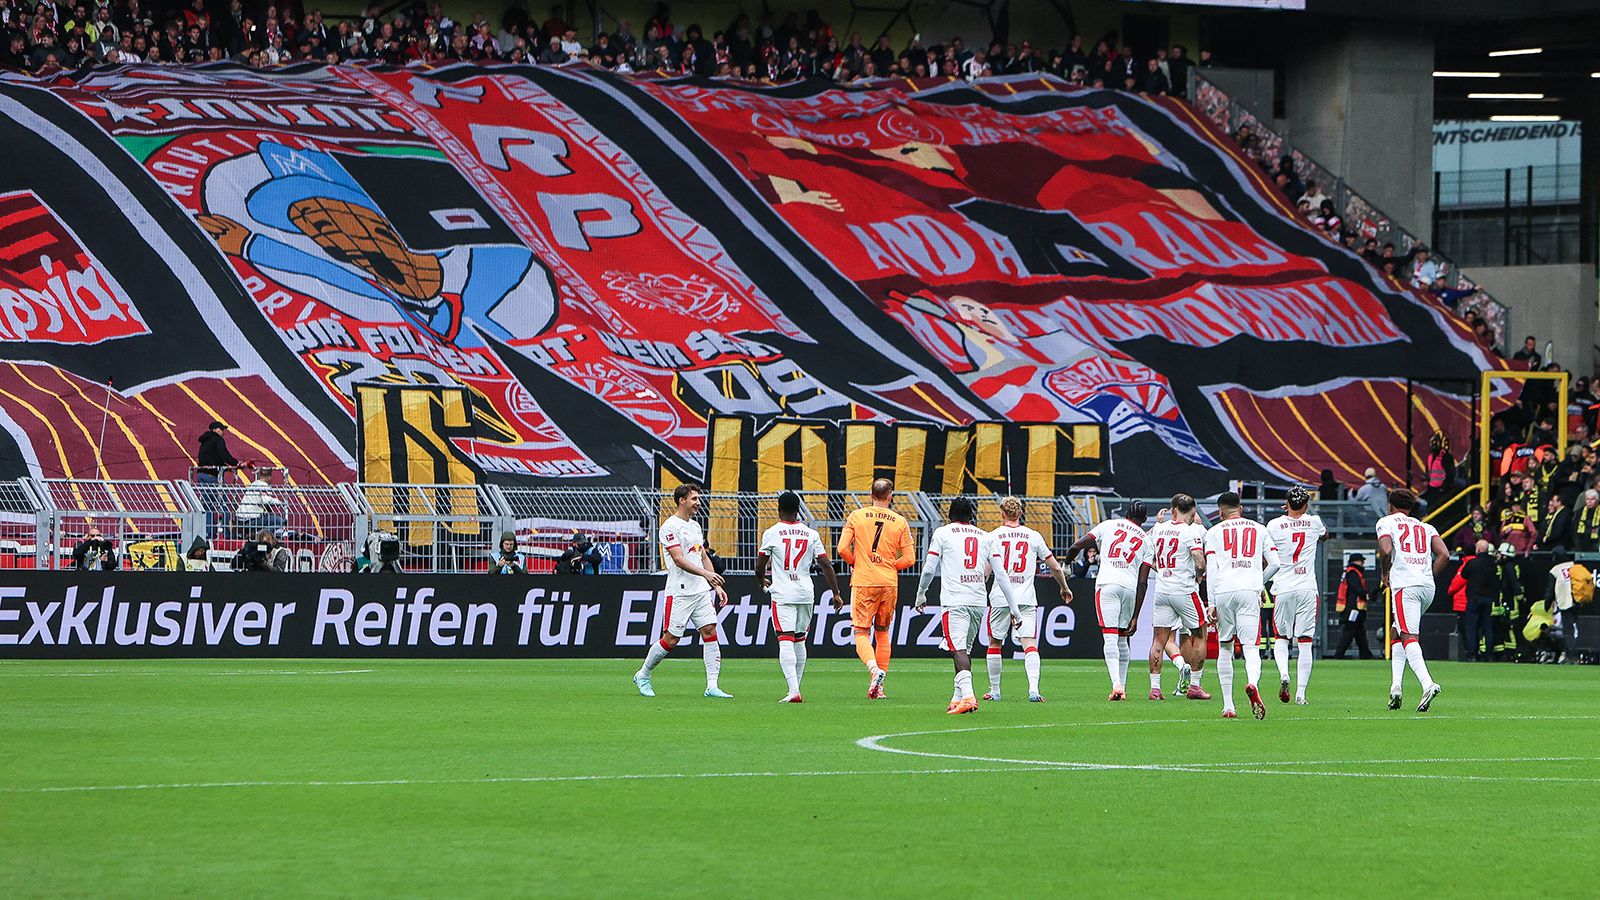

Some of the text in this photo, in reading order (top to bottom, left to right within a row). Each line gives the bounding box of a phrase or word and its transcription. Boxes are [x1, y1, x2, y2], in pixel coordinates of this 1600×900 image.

[1433, 124, 1568, 146] NTSCHEIDEND
[788, 528, 810, 537] LEIPZIG
[871, 521, 884, 553] 1
[1007, 532, 1030, 540] LEIPZIG
[1289, 520, 1311, 528] LEIPZIG
[1397, 523, 1427, 554] 20
[782, 538, 809, 571] 17
[963, 536, 978, 570] 9
[1001, 541, 1029, 574] 13
[1107, 529, 1143, 564] 23
[1155, 537, 1179, 569] 22
[1223, 527, 1257, 559] 40
[1292, 531, 1306, 564] 7
[0, 585, 297, 646] Exklusiver
[311, 587, 499, 647] Reifen
[517, 587, 600, 647] für
